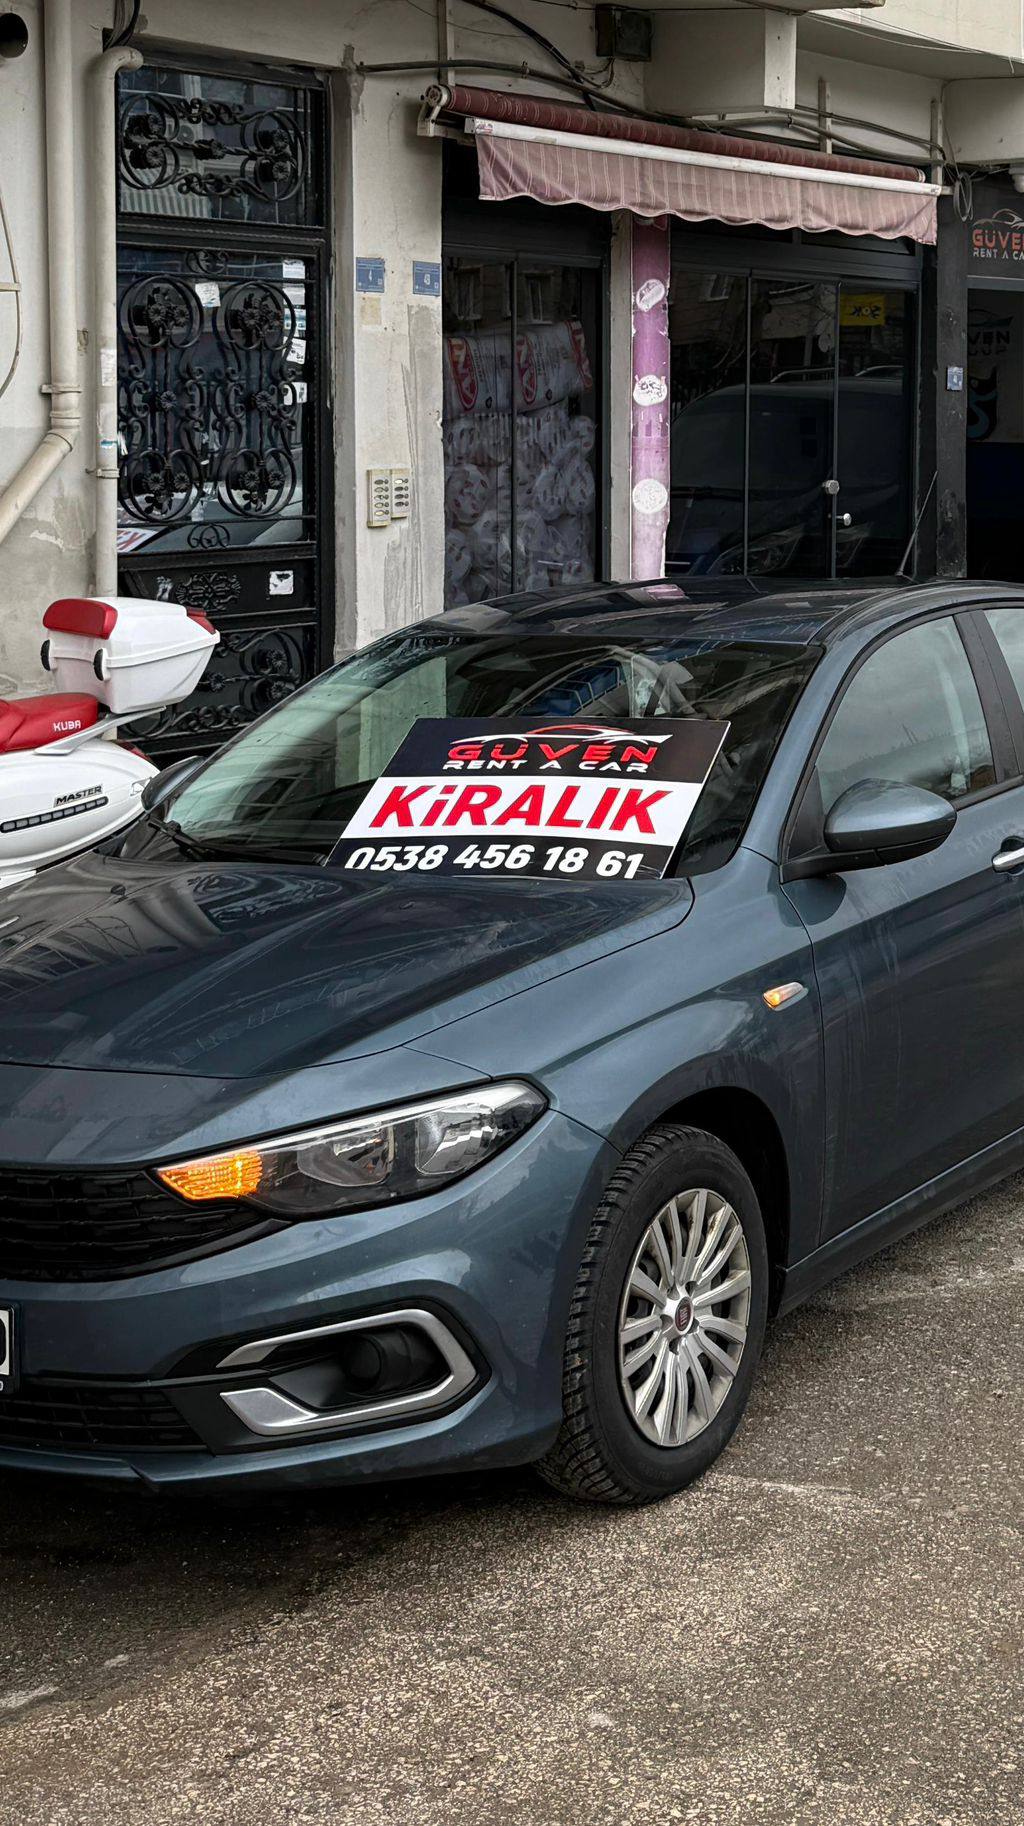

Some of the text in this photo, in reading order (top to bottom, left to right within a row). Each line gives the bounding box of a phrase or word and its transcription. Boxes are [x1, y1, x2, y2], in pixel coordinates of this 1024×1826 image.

[973, 247, 998, 260] RENT
[1001, 250, 1009, 260] A
[53, 719, 82, 732] KUBA
[447, 743, 658, 763] GÜVEN
[442, 760, 649, 773] RENT A CAR
[56, 785, 102, 805] MASTER
[344, 844, 644, 880] 0538 456 18 61
